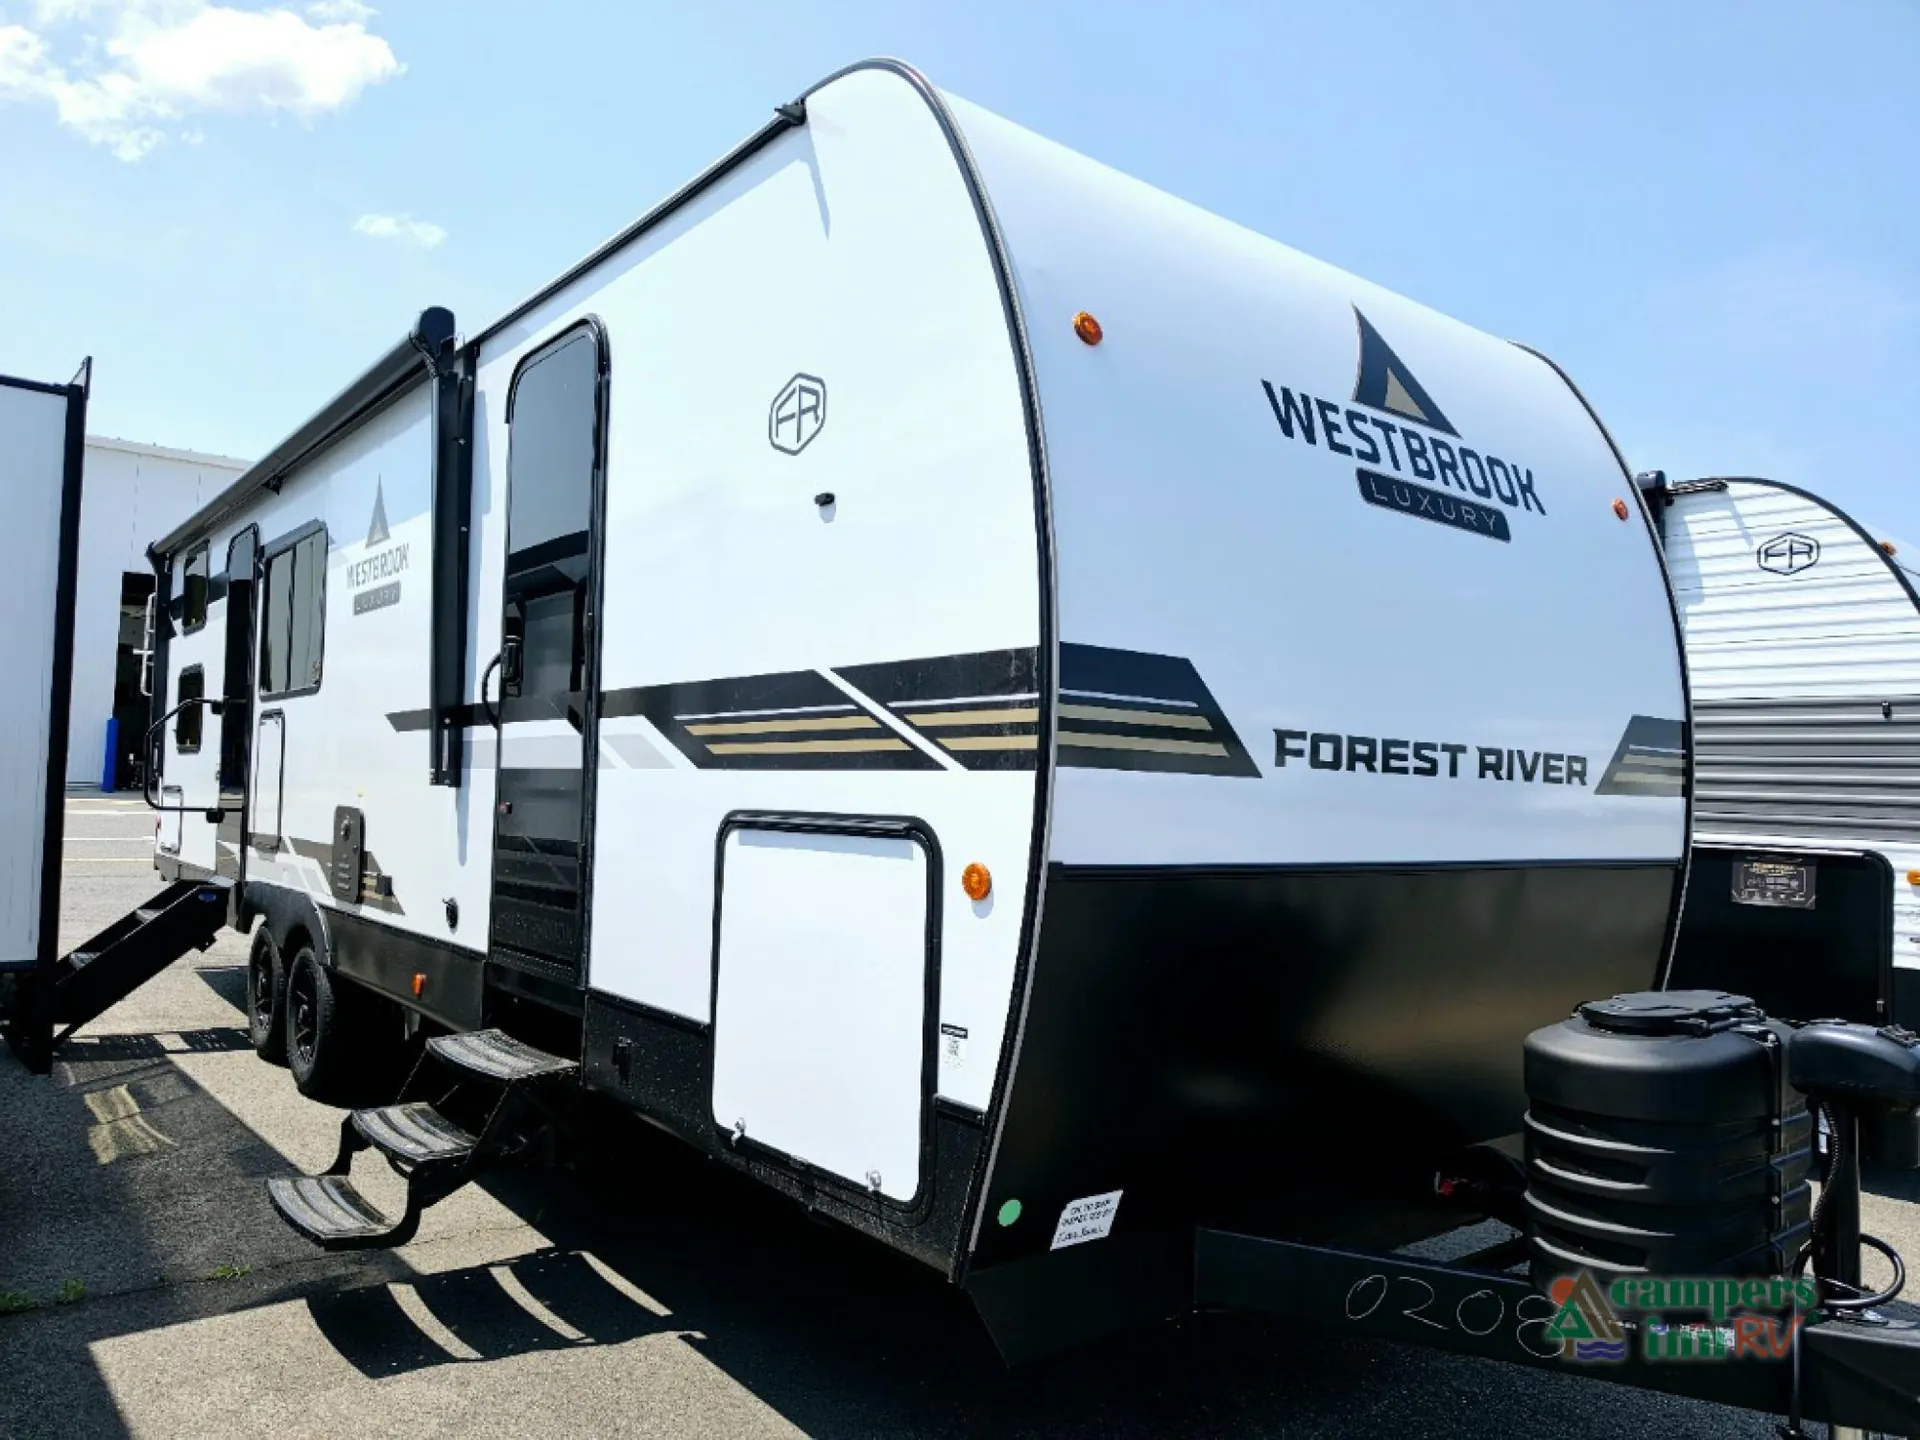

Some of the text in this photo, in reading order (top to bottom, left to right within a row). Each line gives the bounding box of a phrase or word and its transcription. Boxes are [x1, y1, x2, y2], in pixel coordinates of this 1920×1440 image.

[1260, 378, 1547, 516] WESTBROOK
[1368, 477, 1500, 532] LUXURY
[1273, 728, 1588, 785] FOREST RIVER
